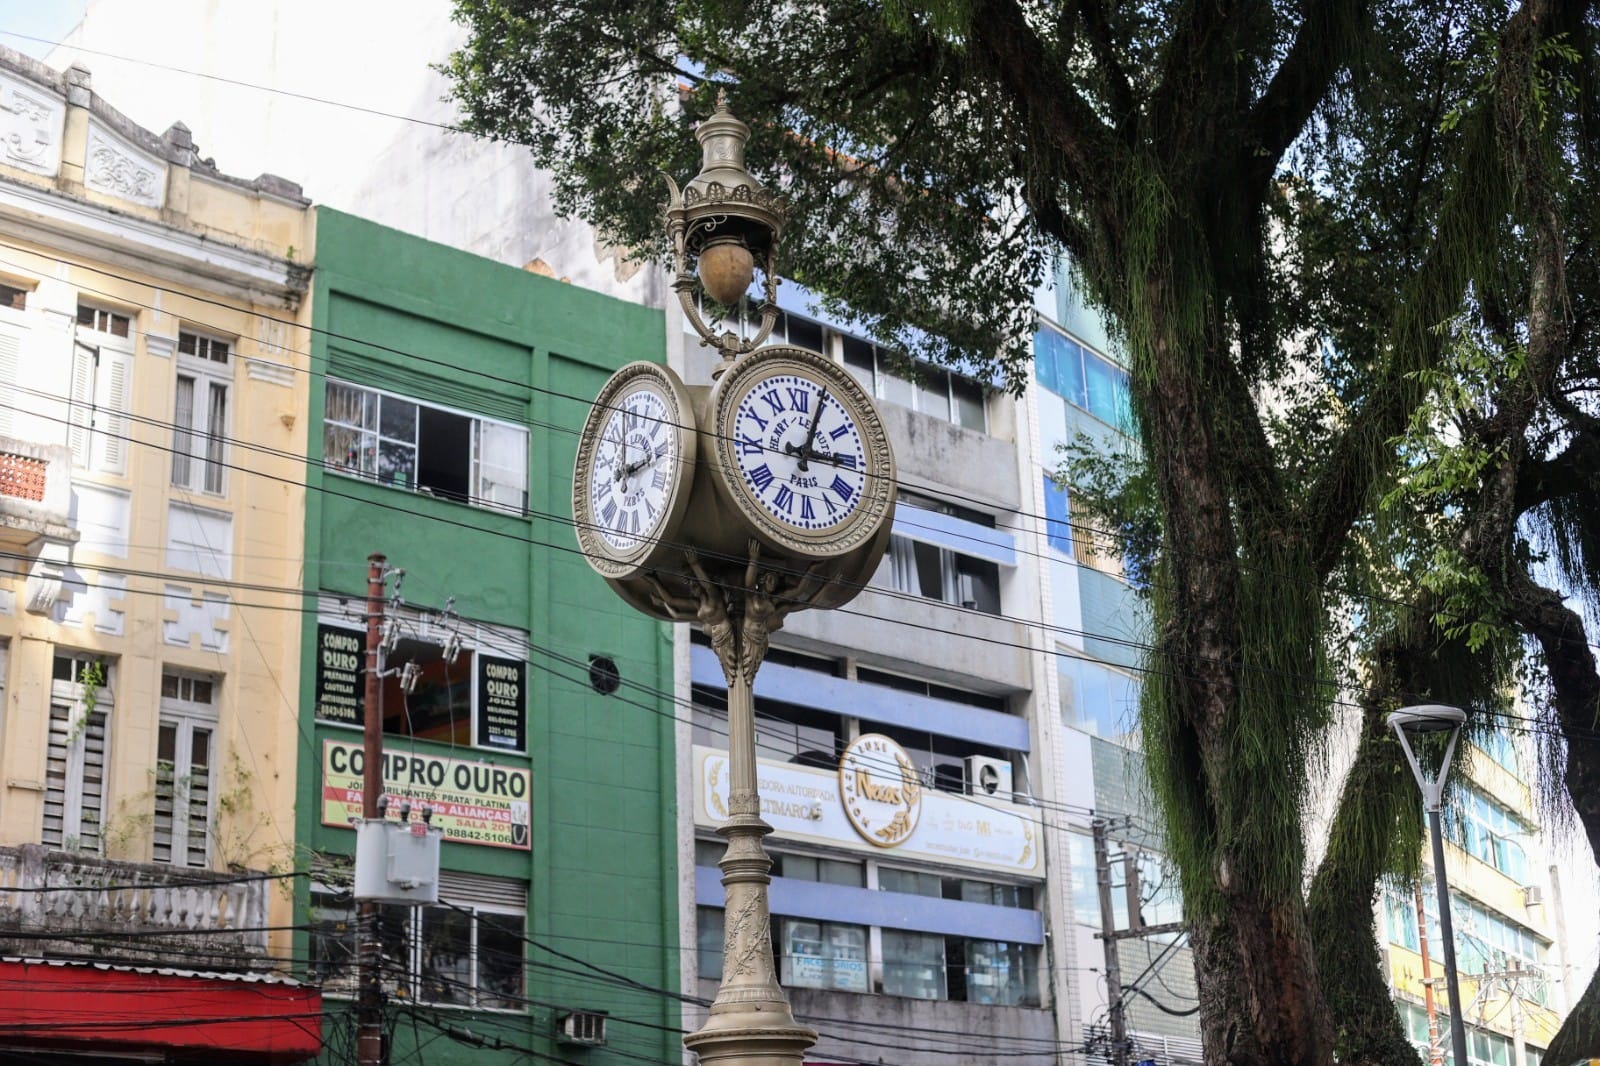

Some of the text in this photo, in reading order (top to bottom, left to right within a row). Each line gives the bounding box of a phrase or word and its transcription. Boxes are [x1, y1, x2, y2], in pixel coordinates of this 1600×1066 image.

[761, 388, 786, 416] XI
[786, 387, 810, 413] XII
[746, 406, 769, 432] X
[790, 474, 818, 489] PARIS
[324, 632, 359, 652] COMPRO
[324, 650, 358, 669] OURO
[486, 664, 518, 682] COMPRO
[486, 680, 518, 698] OURO
[488, 697, 516, 706] JOIAS
[454, 764, 526, 798] OURO
[475, 798, 511, 810] PLATINA
[448, 805, 510, 822] ALIANÇAS
[456, 819, 487, 829] SALA
[491, 824, 511, 832] 201
